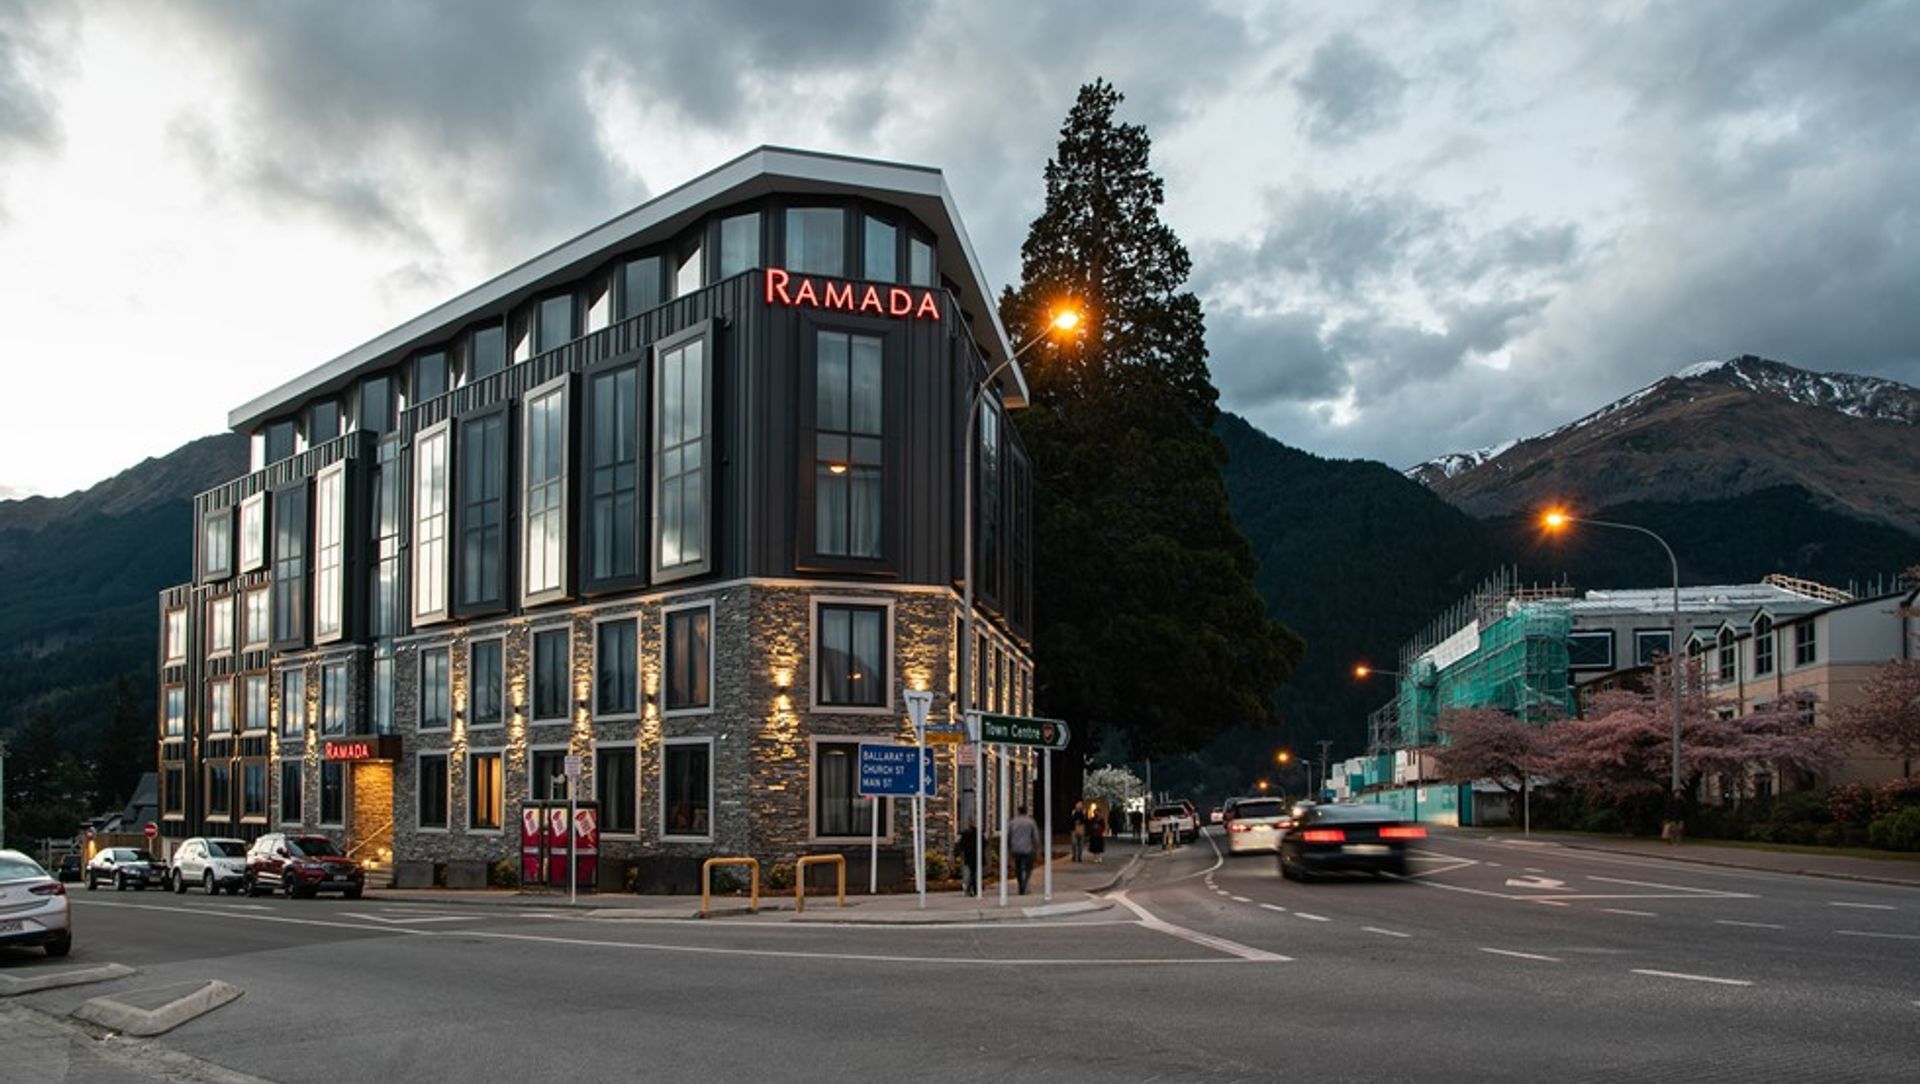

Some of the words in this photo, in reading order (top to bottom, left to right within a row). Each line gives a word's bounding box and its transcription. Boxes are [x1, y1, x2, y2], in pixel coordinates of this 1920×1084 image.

[765, 267, 940, 320] RAMADA
[985, 722, 1008, 736] Town
[1011, 724, 1040, 739] Centre
[324, 741, 370, 760] RAMADA
[862, 750, 904, 761] BALLARAT
[905, 752, 916, 763] ST
[862, 764, 893, 775] CHURCH
[895, 765, 905, 775] ST
[862, 777, 881, 788] MAIN
[882, 778, 893, 788] ST
